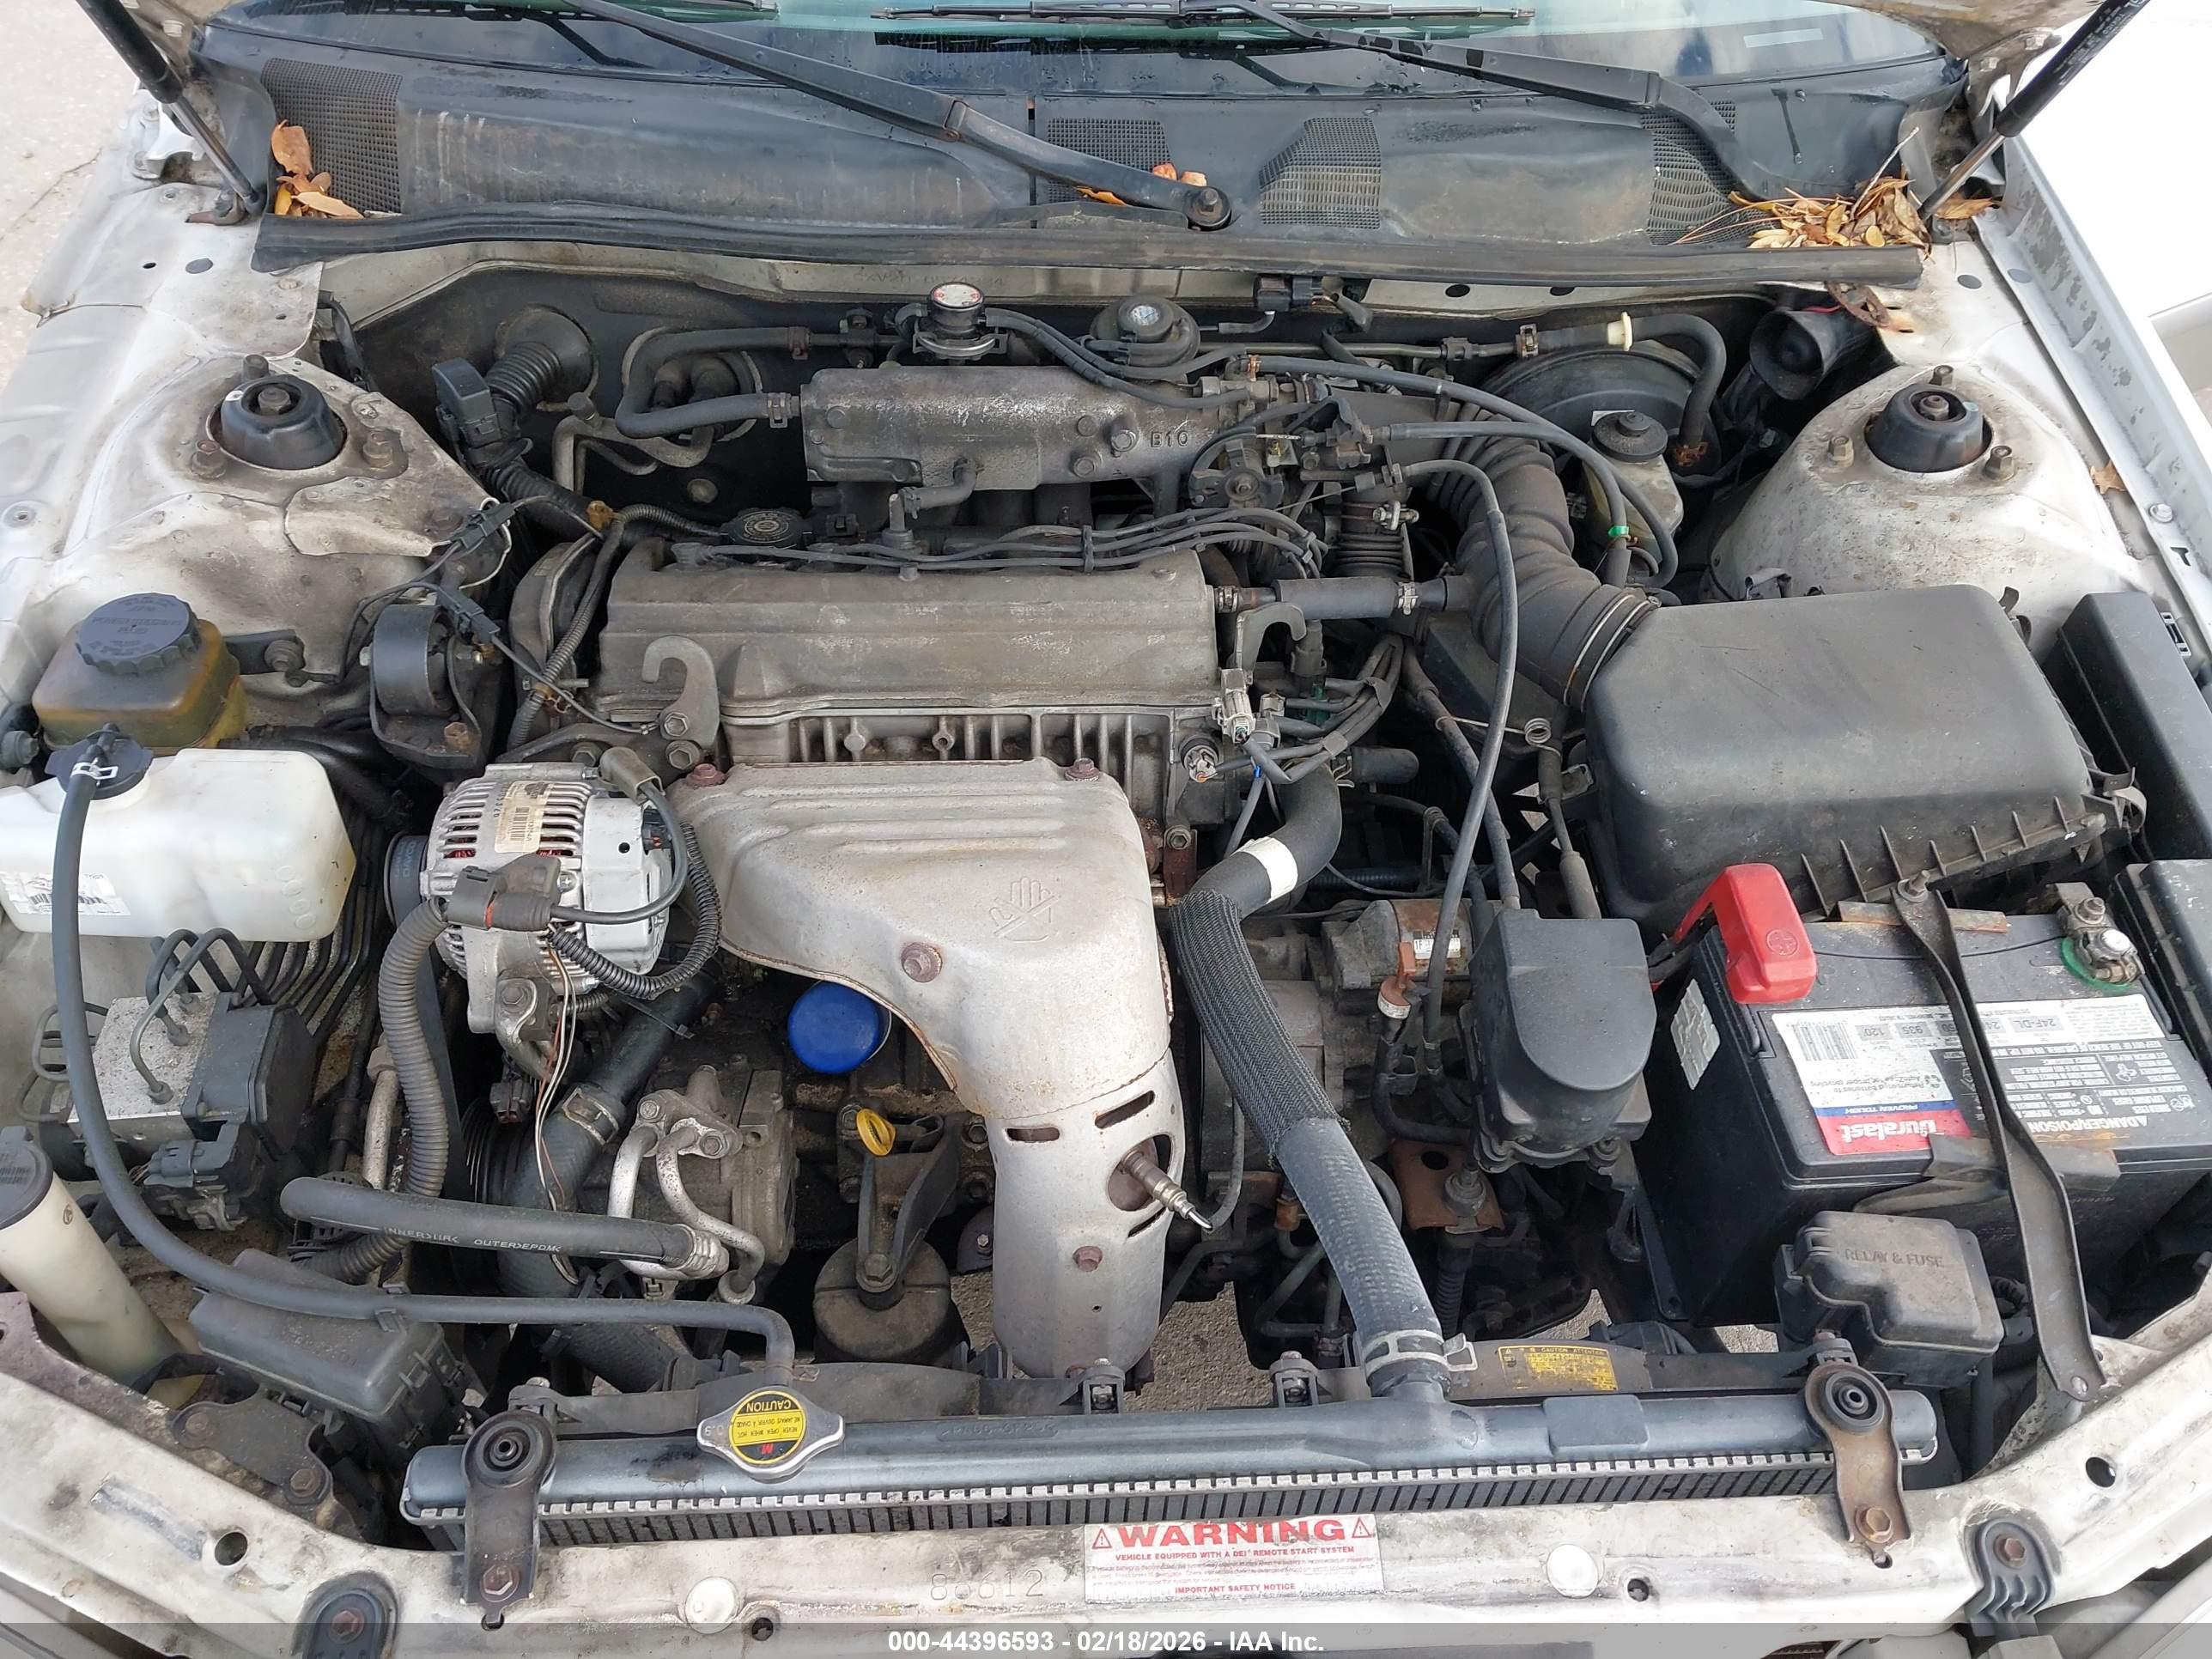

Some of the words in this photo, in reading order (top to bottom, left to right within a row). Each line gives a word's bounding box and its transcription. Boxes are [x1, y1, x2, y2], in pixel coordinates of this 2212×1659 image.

[1152, 430, 1189, 447] B10
[1864, 1027, 1885, 1036] 120
[1903, 1025, 1923, 1036] 935
[1845, 1249, 1887, 1263] RELAY
[1892, 1252, 1904, 1264] &
[1906, 1254, 1944, 1267] FUSE
[746, 1400, 791, 1413] CAUTION
[1118, 1520, 1345, 1547] WARNING
[1155, 1552, 1197, 1560] EQUIPPED
[1253, 1548, 1289, 1557] REMOTE
[1320, 1546, 1355, 1554] SYSTEM
[1175, 1585, 1225, 1594] IMPORTANT
[1227, 1584, 1261, 1593] SAFETY
